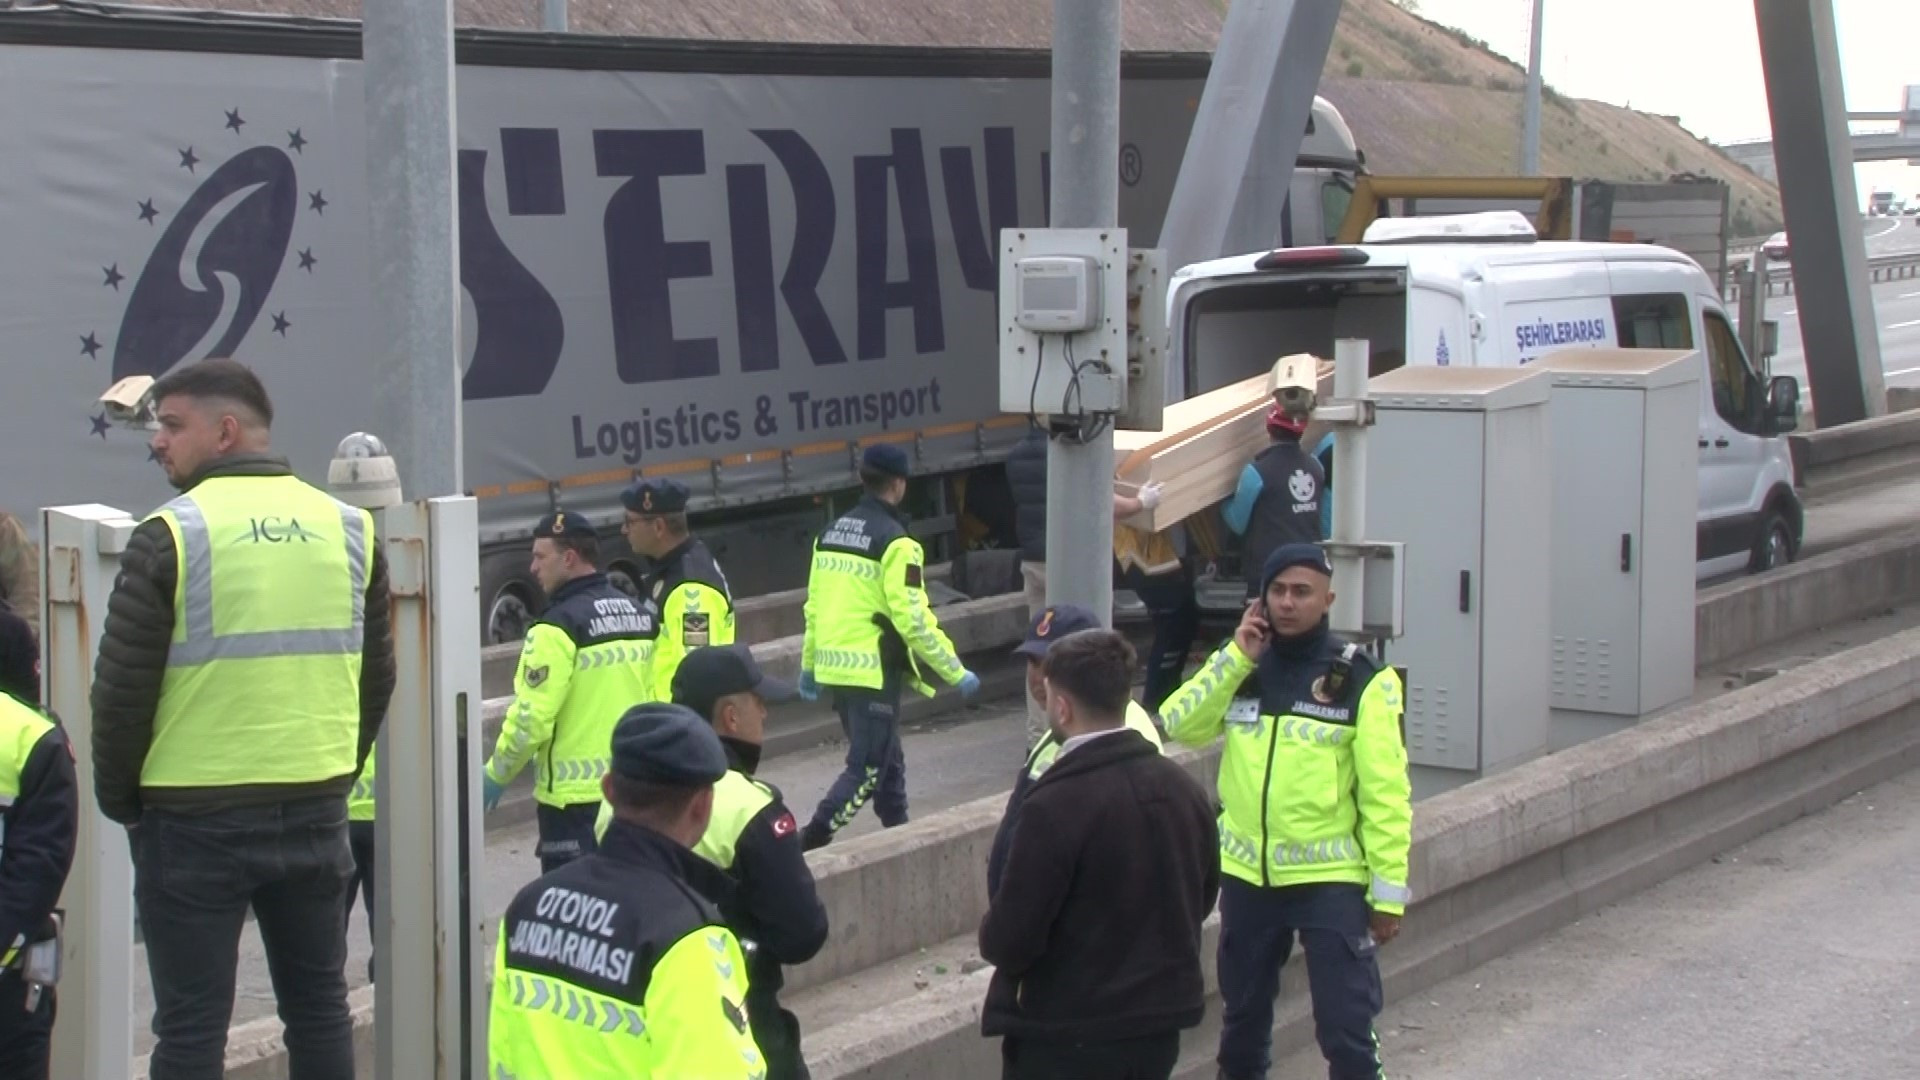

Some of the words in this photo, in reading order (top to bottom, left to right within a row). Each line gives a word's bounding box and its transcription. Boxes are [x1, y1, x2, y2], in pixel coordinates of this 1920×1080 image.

[1516, 316, 1606, 352] ŞEHİRLERARASI
[571, 402, 742, 465] Logistics
[754, 394, 778, 437] &
[788, 377, 942, 432] Transport
[249, 515, 308, 543] ICA
[536, 886, 619, 937] OTOYOL
[509, 919, 635, 985] JANDARMASI
